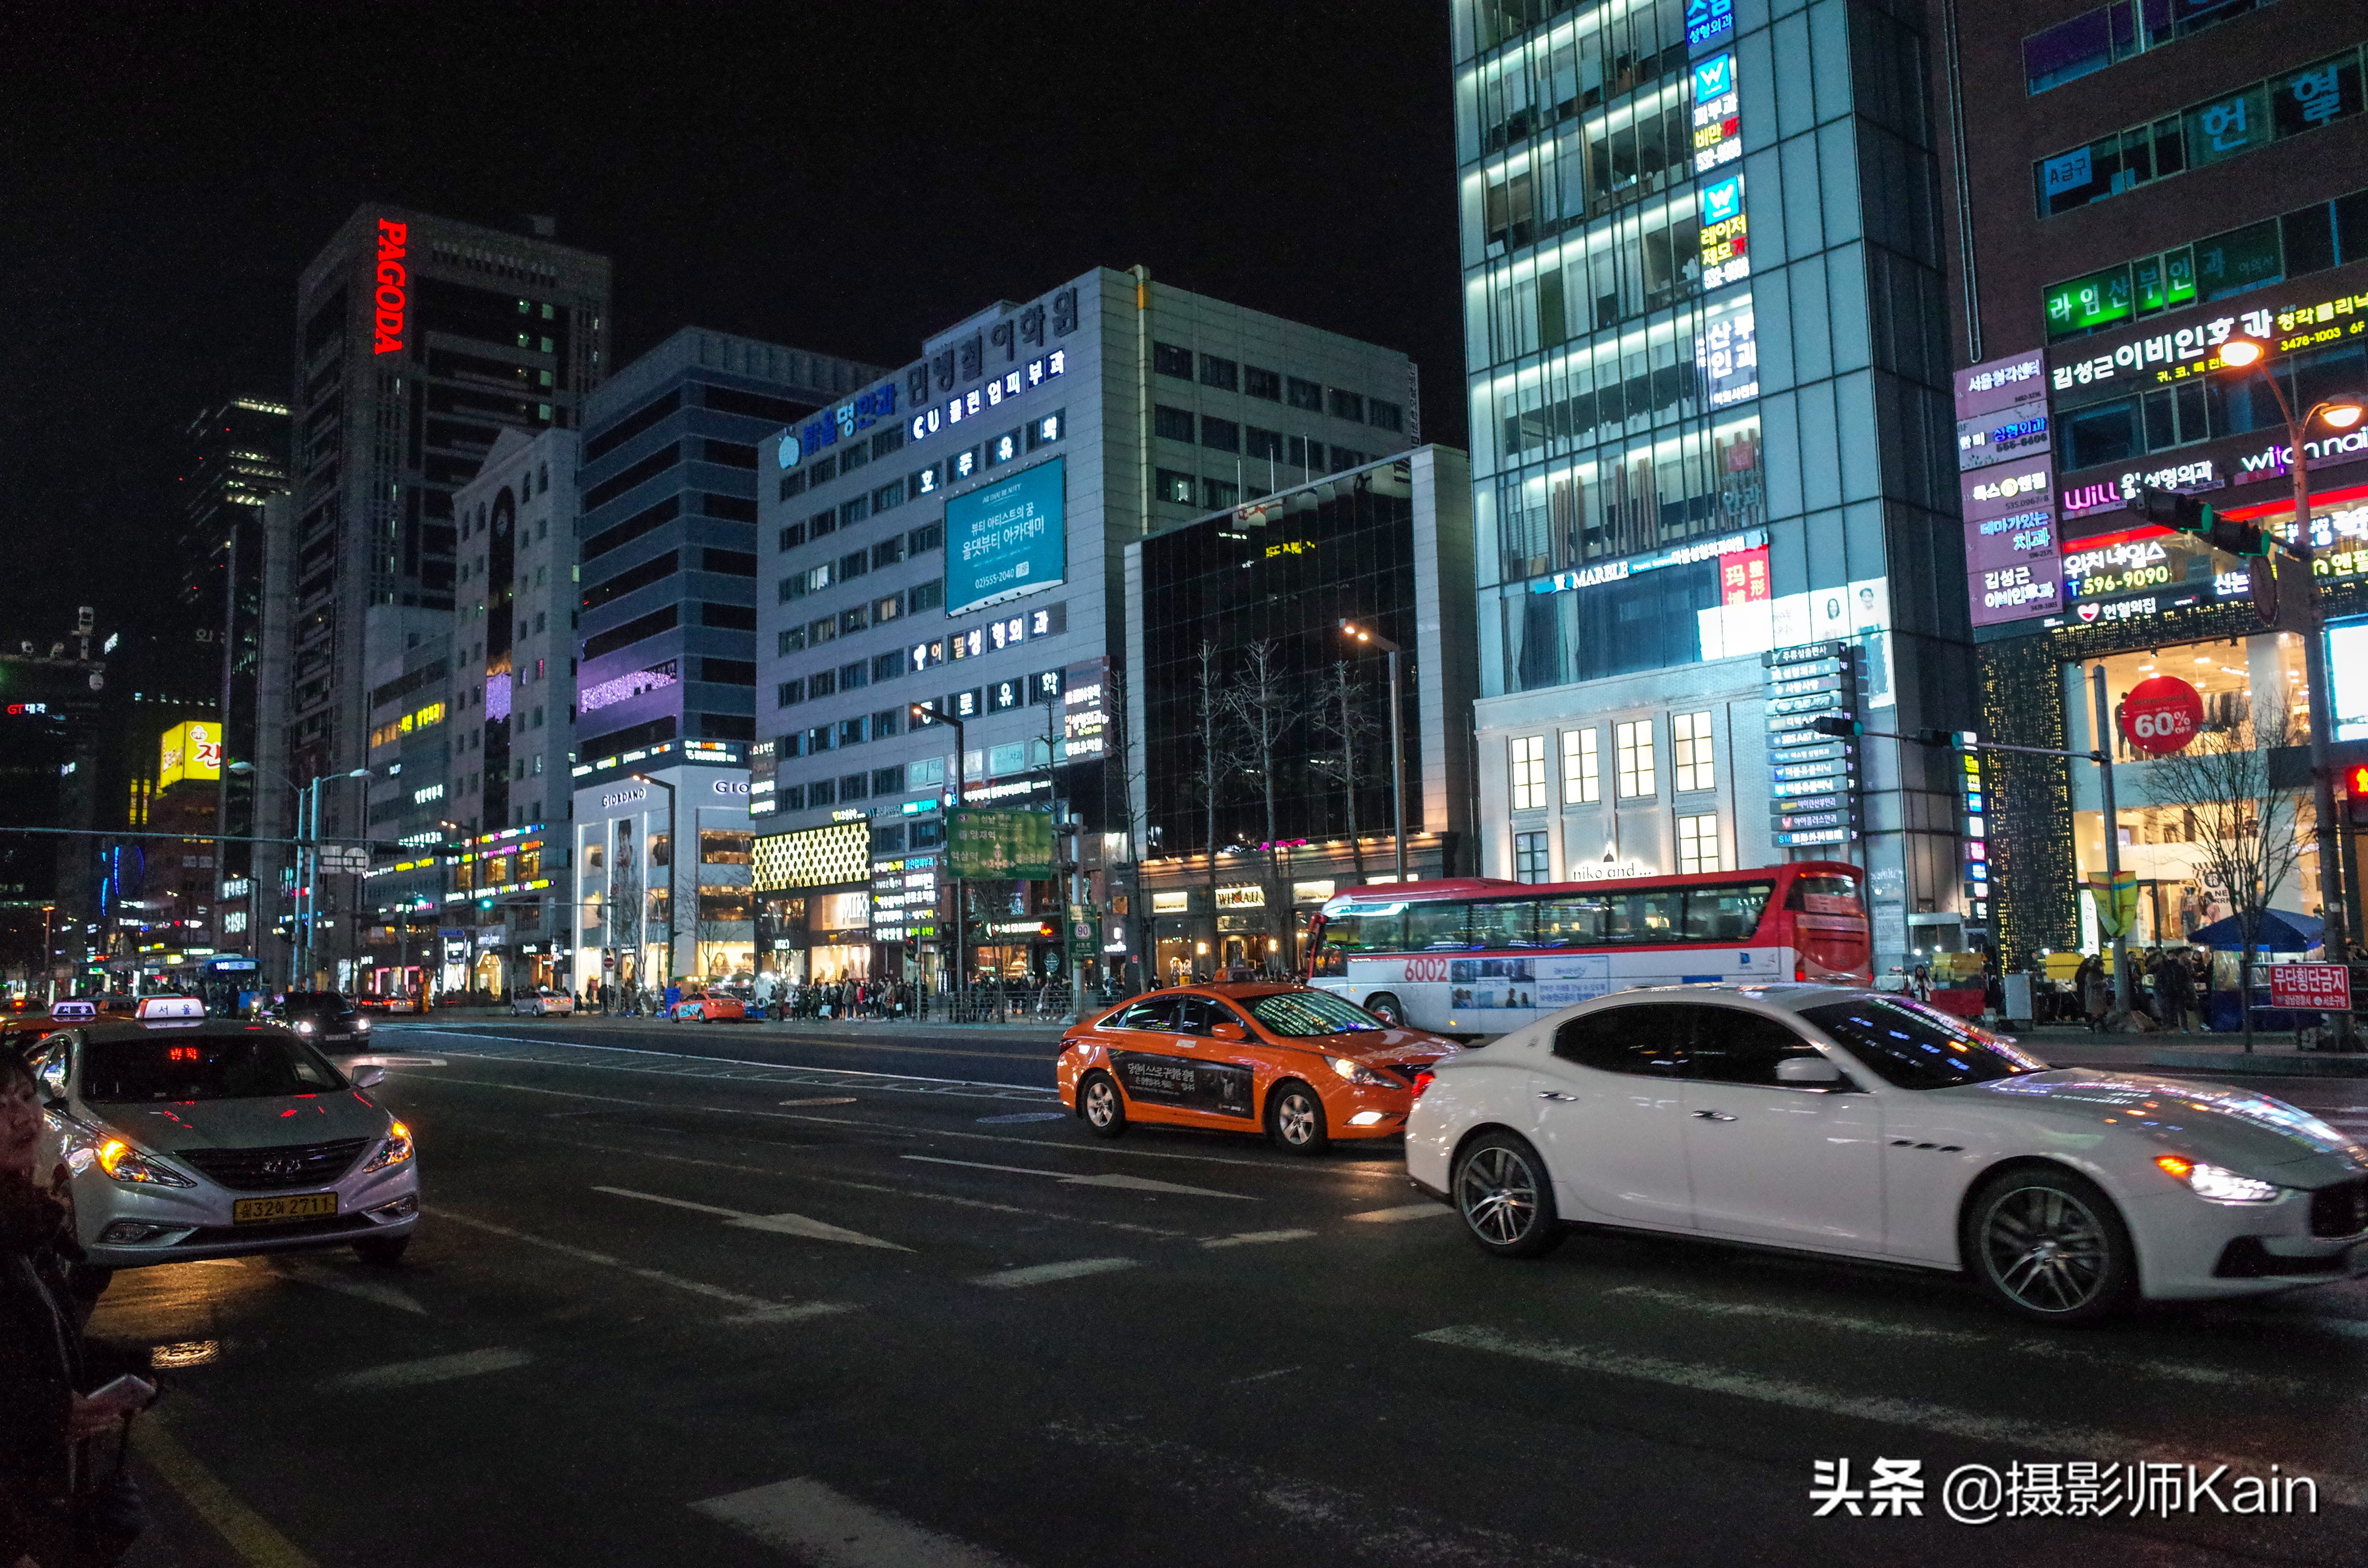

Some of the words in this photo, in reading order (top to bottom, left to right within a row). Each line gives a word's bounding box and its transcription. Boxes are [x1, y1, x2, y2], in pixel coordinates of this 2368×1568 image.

[1690, 13, 1733, 43] 성형외과
[1700, 62, 1724, 86] W
[1694, 93, 1738, 126] 피부과
[1695, 122, 1722, 148] 비만
[1708, 184, 1734, 206] W
[1701, 215, 1747, 245] 레이저
[1702, 242, 1732, 266] 제모
[374, 218, 407, 355] PAGODA
[1710, 312, 1755, 350] 산부
[2281, 327, 2342, 352] 3478-1003
[2350, 321, 2365, 334] 6F
[1711, 341, 1757, 379] 인과
[2053, 355, 2114, 390] 김성근
[2116, 308, 2273, 370] 이비인후과
[1968, 359, 2041, 392] 서울청각센터
[913, 409, 940, 439] CU
[949, 350, 1065, 424] 클린업피부과
[1993, 417, 2047, 442] 성형외과
[2324, 426, 2368, 456] nai
[921, 417, 1057, 493] 호주유학
[2064, 481, 2121, 510] Will
[2145, 460, 2213, 490] 성형외과
[972, 519, 985, 536] 뷰티
[987, 505, 1024, 529] 아티스트의
[1026, 502, 1034, 517] 꿈
[1980, 512, 2049, 536] 테마가있는
[962, 531, 1000, 561] 올댓뷰티
[1004, 515, 1044, 545] 아카데미
[2013, 527, 2051, 551] 치과
[975, 568, 1014, 589] 02)555-2040
[1571, 561, 1629, 589] MARBLE
[1749, 560, 1765, 600] 整形
[1985, 566, 2030, 590] 김성근
[2067, 566, 2168, 597] T.596-9090
[2215, 572, 2251, 596] 신논
[1985, 581, 2055, 609] 이비인후과
[2103, 597, 2157, 620] 헌혈의집
[1072, 710, 1102, 730] 성형외과
[2135, 711, 2191, 738] 60%
[2175, 725, 2191, 734] OFF
[602, 788, 646, 807] GIORDANO
[970, 830, 996, 841] 양재역
[1778, 834, 1791, 844] SM
[950, 851, 978, 862] 역삼역
[1573, 867, 1602, 881] niko
[1607, 863, 1634, 878] and
[1078, 926, 1088, 936] 90
[1405, 958, 1448, 982] 6002
[2274, 968, 2344, 992] 무단횡단금지
[158, 1004, 192, 1016] 서울
[1145, 1065, 1162, 1077] 스스로
[290, 1198, 328, 1214] 2711
